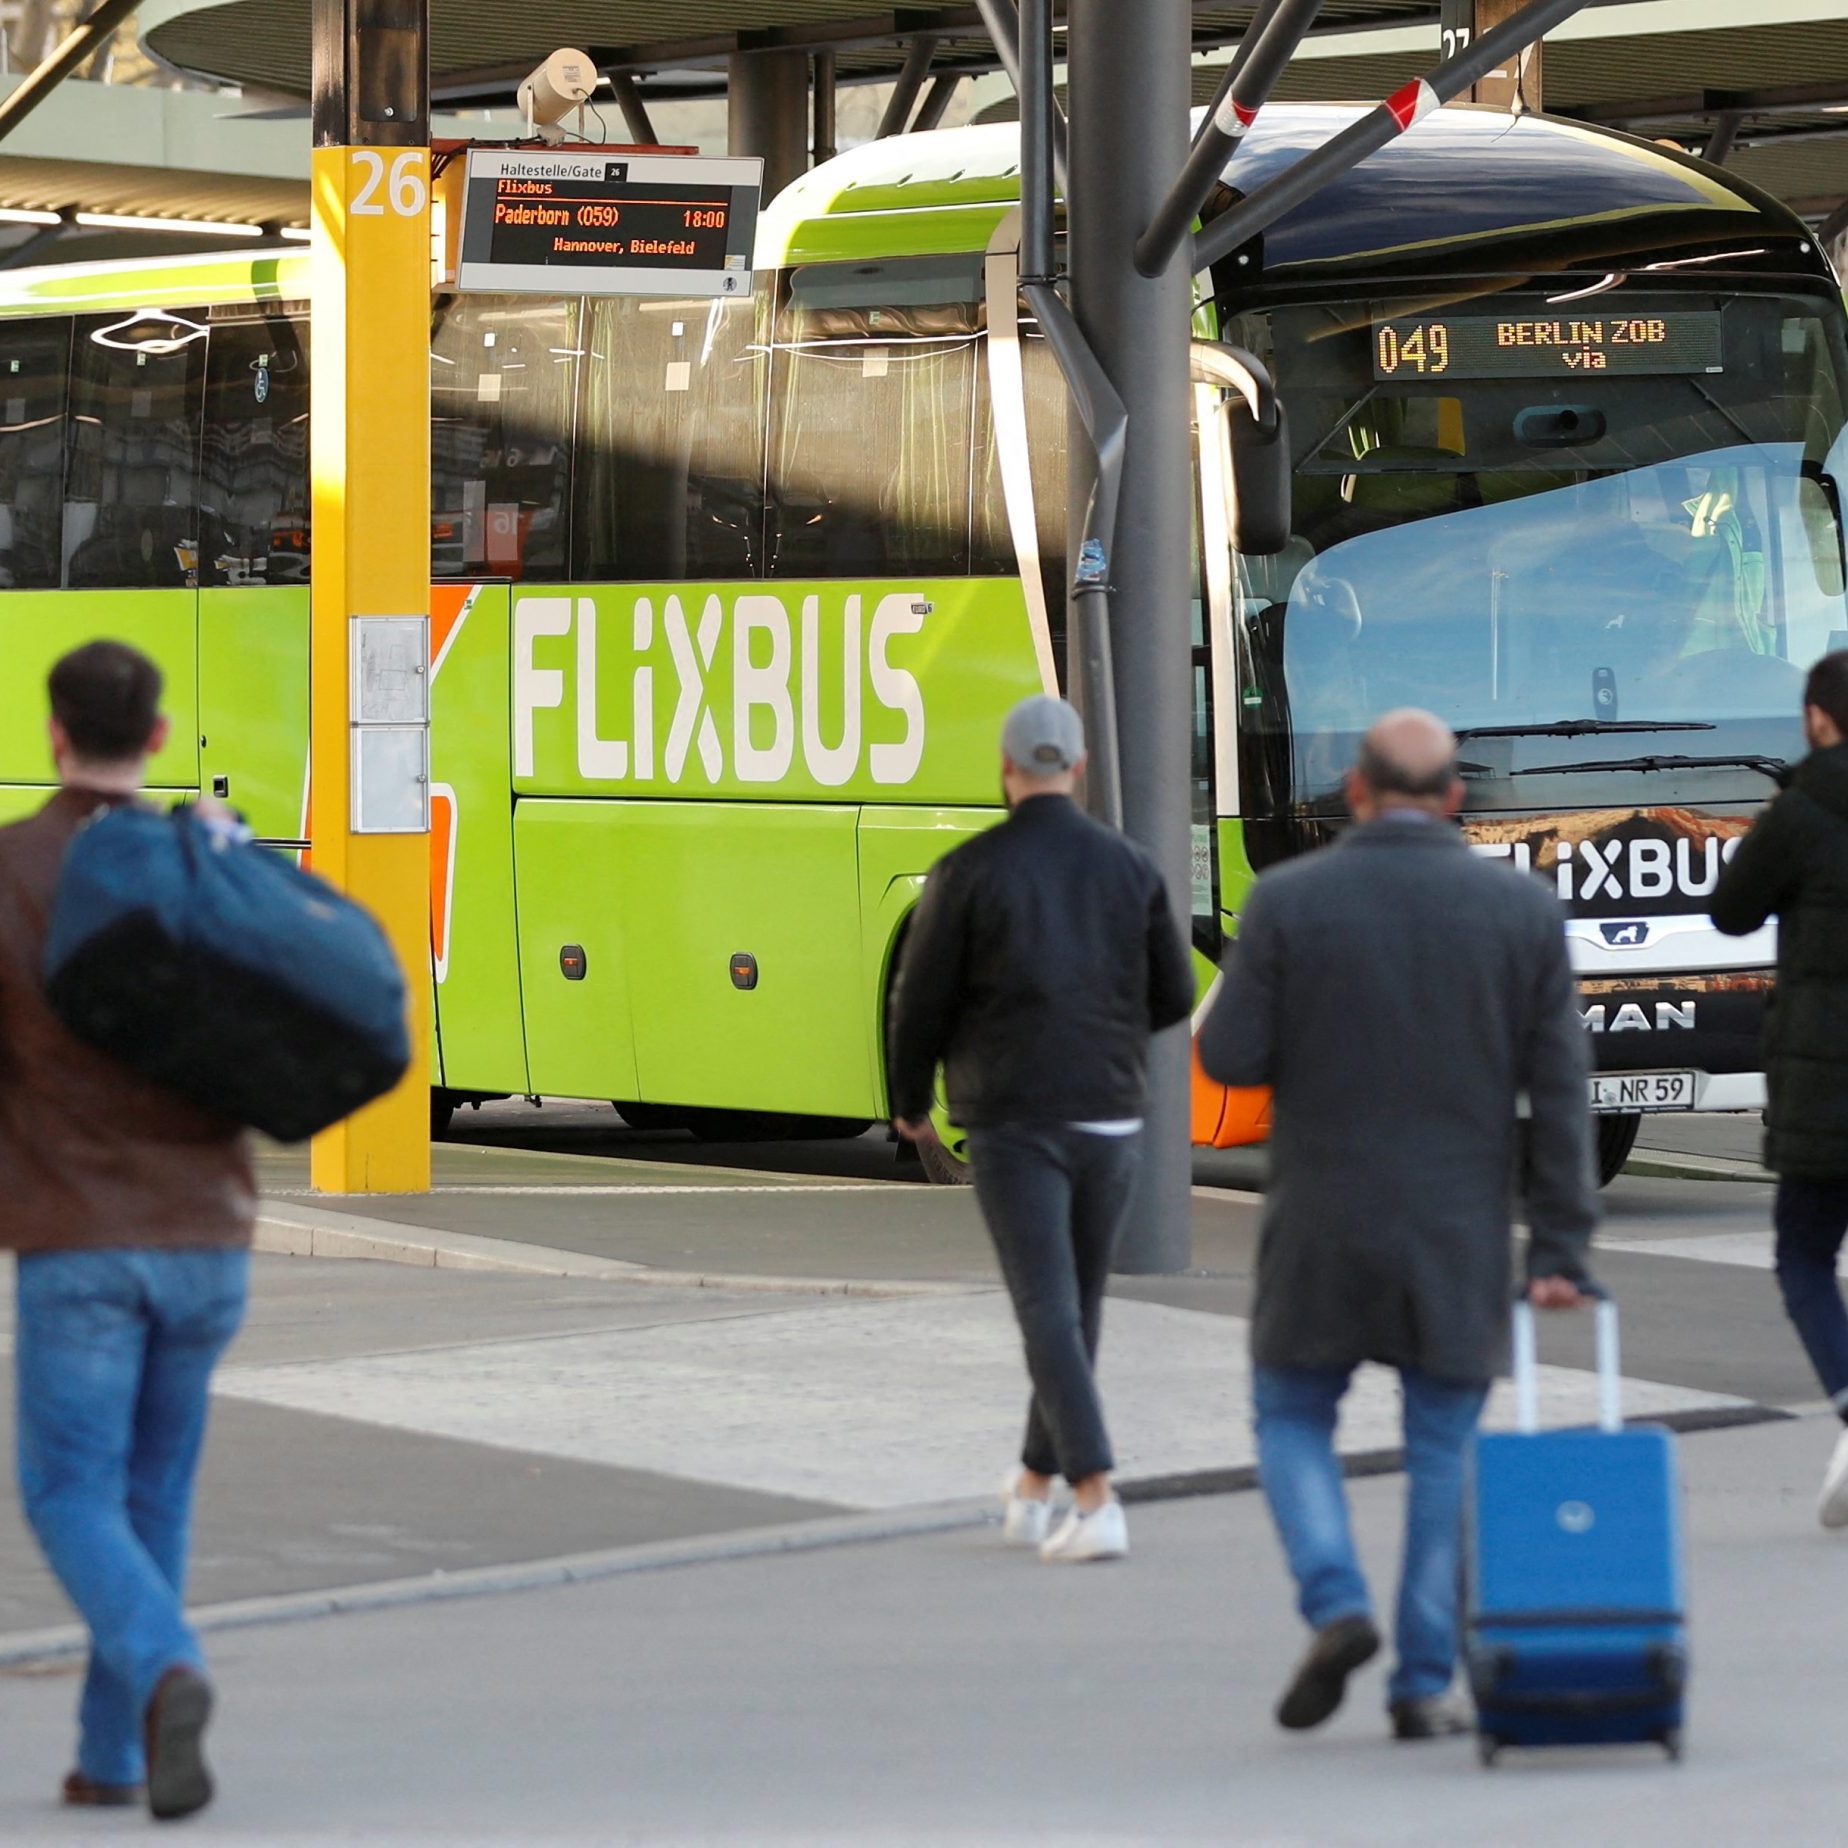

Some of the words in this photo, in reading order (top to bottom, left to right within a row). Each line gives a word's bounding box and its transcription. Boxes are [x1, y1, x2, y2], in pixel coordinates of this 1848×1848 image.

[500, 163, 602, 178] Haltestelle/Gate
[610, 168, 621, 177] 26
[350, 150, 426, 217] 26
[497, 179, 553, 194] Flixbus
[495, 203, 570, 226] Paderborn
[577, 205, 619, 227] (059)
[683, 210, 725, 228] 18:00
[553, 237, 624, 255] Hannover,
[630, 239, 695, 255] Bielefeld
[1497, 321, 1602, 346] BERLIN
[1610, 319, 1665, 343] ZOB
[1378, 324, 1449, 374] 049
[1562, 345, 1607, 369] via
[1469, 836, 1744, 900] iXBU
[1619, 1079, 1649, 1102] NR
[1655, 1077, 1684, 1102] 59
